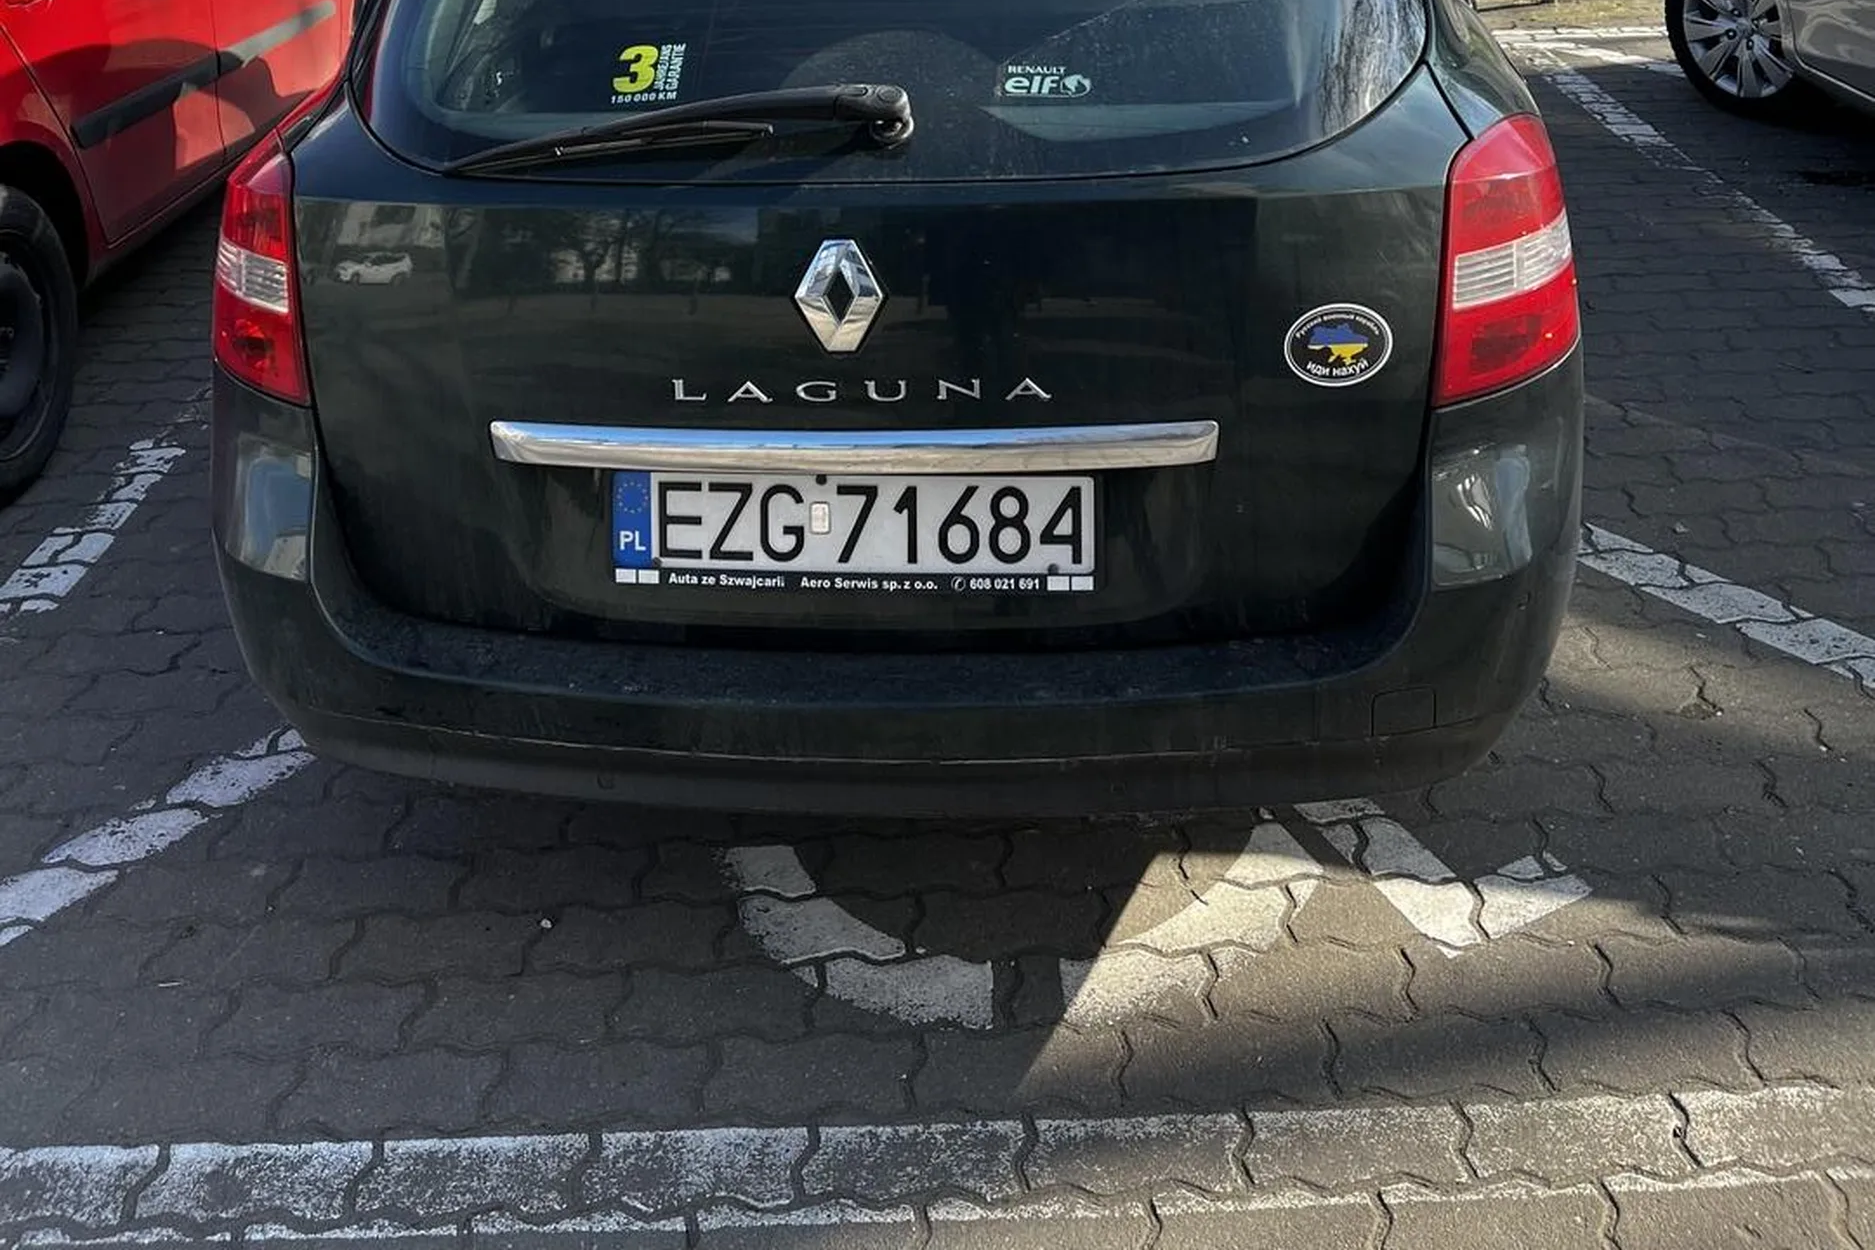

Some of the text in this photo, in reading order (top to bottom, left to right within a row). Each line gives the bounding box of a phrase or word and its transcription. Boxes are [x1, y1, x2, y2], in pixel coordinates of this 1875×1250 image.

[612, 45, 659, 93] 3
[1008, 65, 1067, 74] RENAULT
[1004, 75, 1060, 94] elf
[671, 378, 1053, 403] LAGUNA
[658, 481, 1083, 565] EZG 71684
[619, 530, 647, 551] PL
[668, 572, 698, 585] Auta
[701, 575, 716, 585] ze
[800, 576, 831, 588] Aero
[834, 577, 879, 589] Serwis
